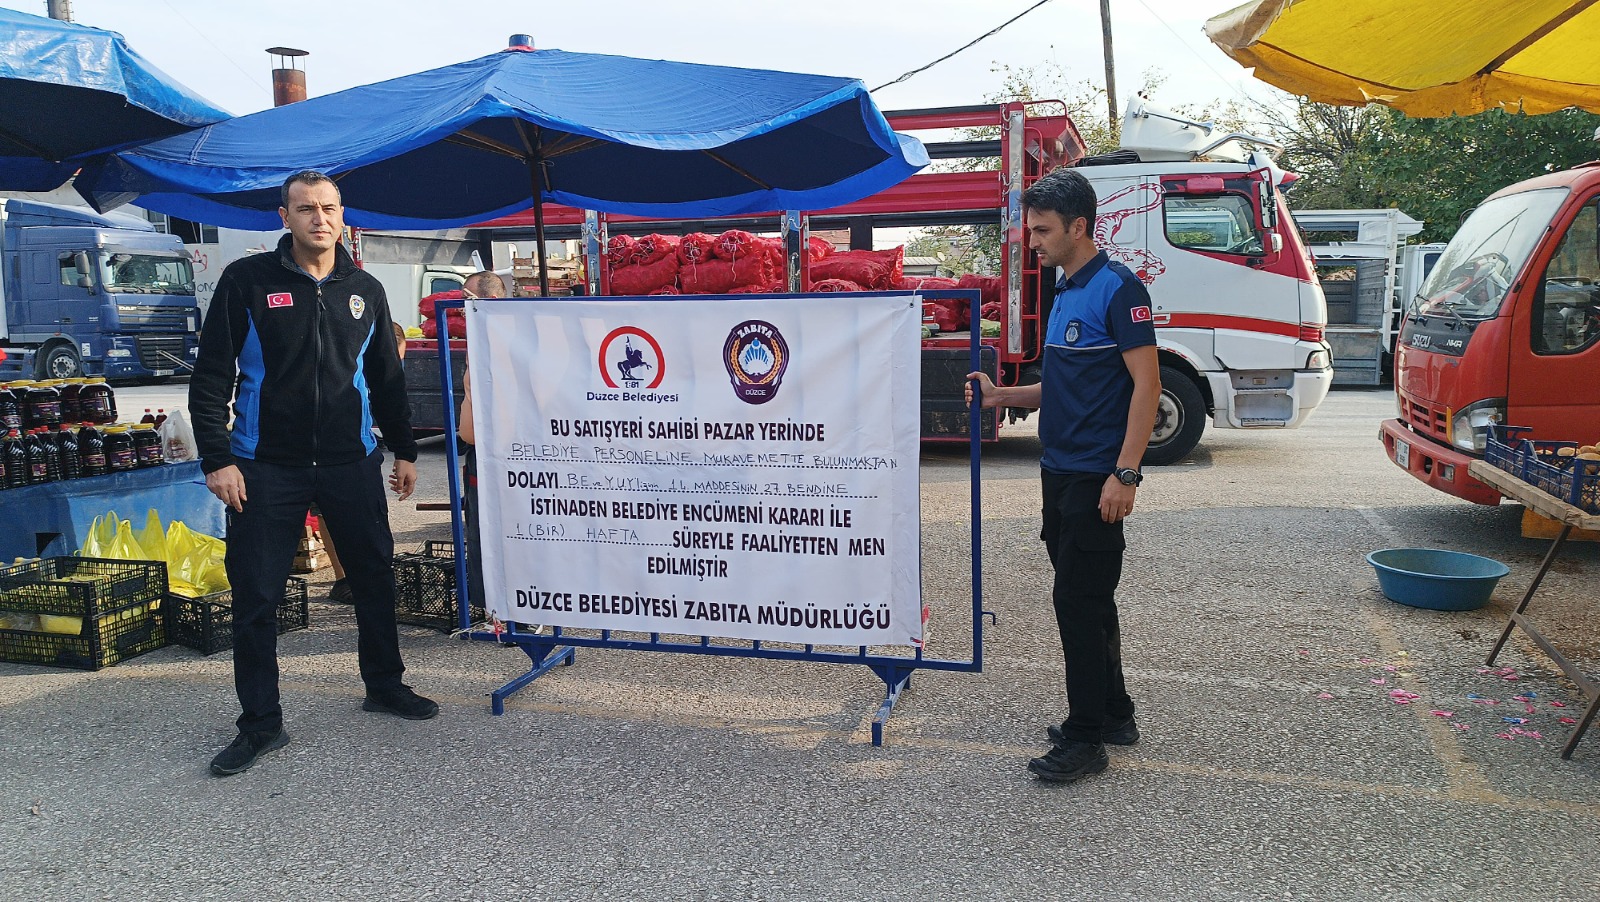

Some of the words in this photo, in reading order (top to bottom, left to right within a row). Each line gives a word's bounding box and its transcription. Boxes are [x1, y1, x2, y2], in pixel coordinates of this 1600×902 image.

[737, 324, 773, 339] ZABITA
[586, 390, 620, 402] Düzce
[622, 391, 679, 404] Belediyesi
[745, 388, 767, 396] DÜZCE
[550, 418, 570, 437] BU
[574, 416, 643, 443] SATIŞYERİ
[648, 417, 699, 440] SAHİBİ
[704, 422, 755, 441] PAZAR
[758, 418, 825, 442] YERİNDE
[507, 470, 559, 489] DOLAYI
[531, 493, 607, 518] İSTİNADEN
[612, 498, 678, 521] BELEDİYE
[683, 500, 763, 524] ENCÜMENİ
[769, 507, 824, 527] KARARI
[830, 504, 852, 528] İLE
[672, 526, 734, 551] SÜREYLE
[741, 530, 838, 556] FAALİYETTEN
[849, 538, 885, 556] MEN
[648, 552, 728, 582] EDİLMİŞTİR
[515, 585, 573, 612] DÜZCE
[578, 591, 678, 618] BELEDİYESİ
[683, 600, 752, 624] ZABITA
[757, 601, 890, 630] MÜDÜRLÜĞÜ
